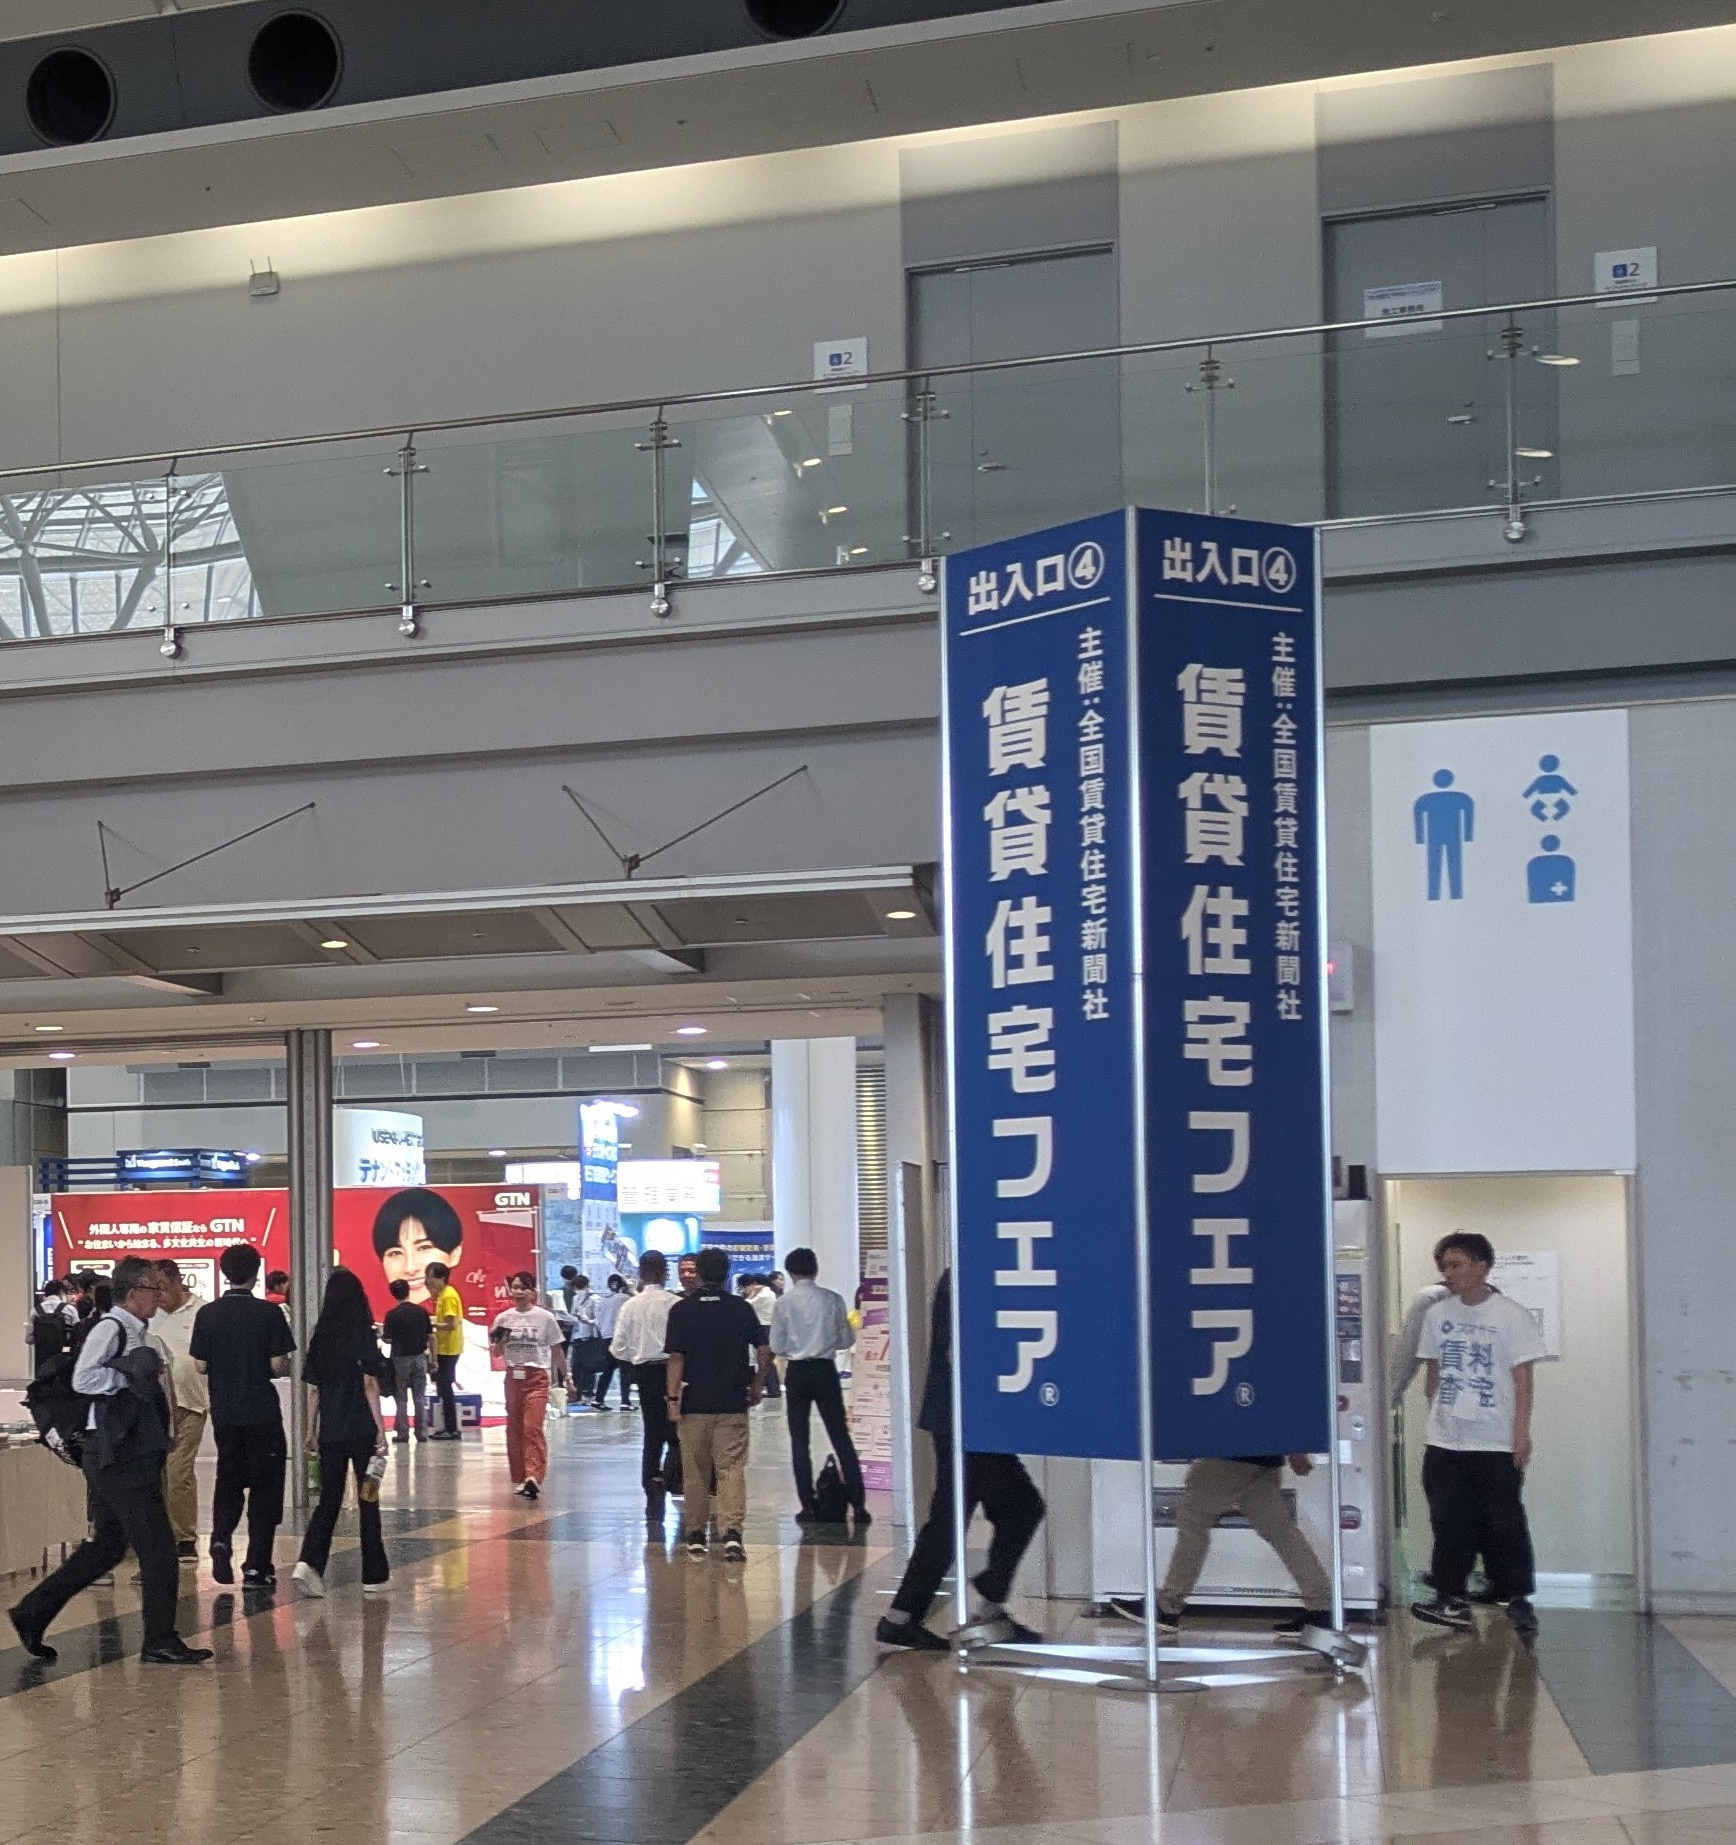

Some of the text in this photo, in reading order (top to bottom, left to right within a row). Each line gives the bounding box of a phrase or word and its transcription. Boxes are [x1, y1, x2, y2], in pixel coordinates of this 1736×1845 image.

[843, 351, 853, 365] 2
[1162, 536, 1297, 594] 出入口④
[967, 541, 1105, 616] 出入口④
[494, 1192, 531, 1207] GTN
[209, 1218, 245, 1234] GTN
